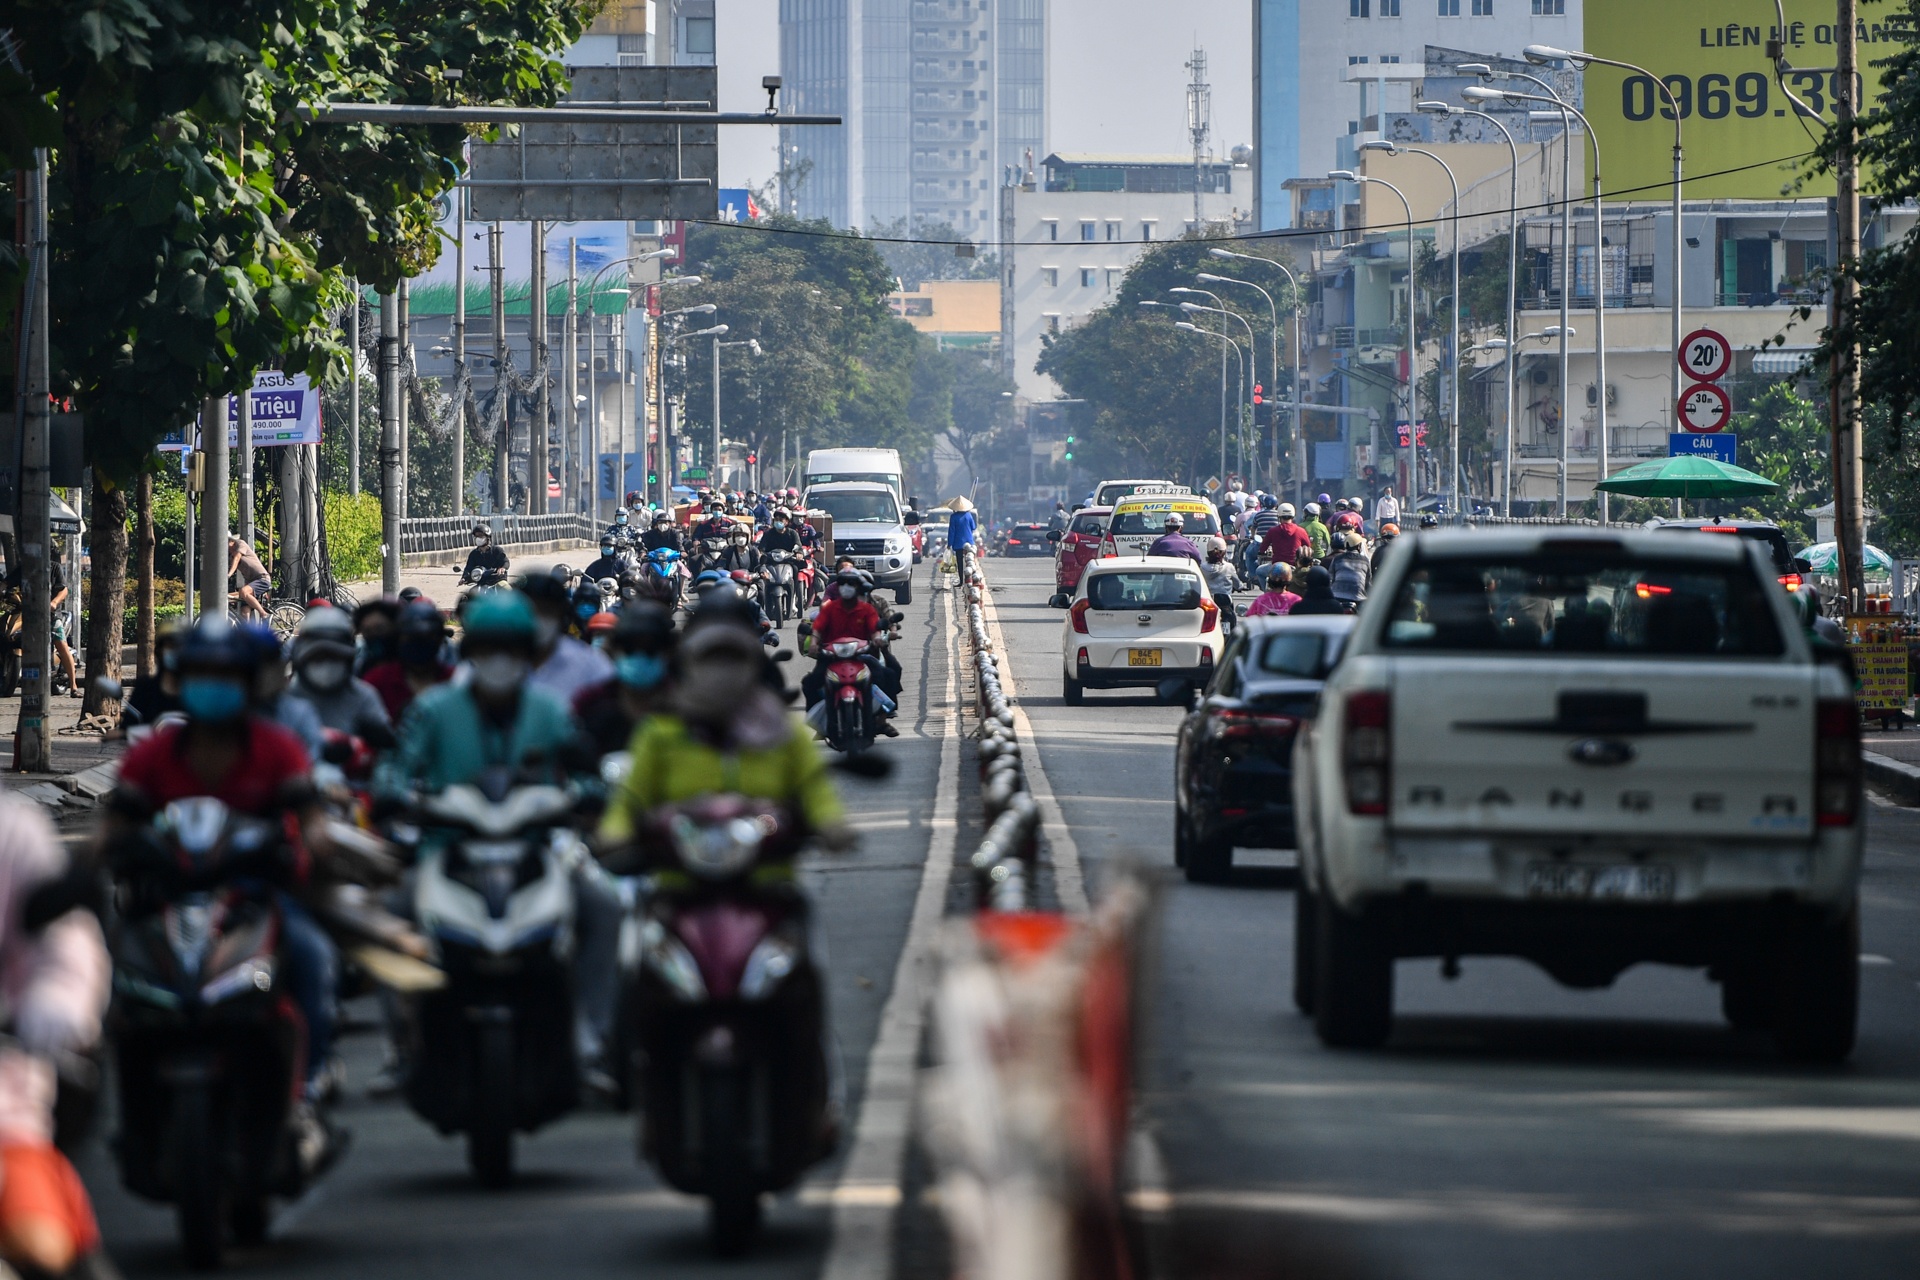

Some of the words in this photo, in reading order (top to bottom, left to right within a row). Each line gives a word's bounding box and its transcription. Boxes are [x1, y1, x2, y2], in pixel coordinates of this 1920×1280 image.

[1700, 22, 1760, 48] LIÊN
[259, 376, 295, 388] ASUS
[251, 396, 296, 418] Triệu
[1409, 785, 1799, 815] RANGER
